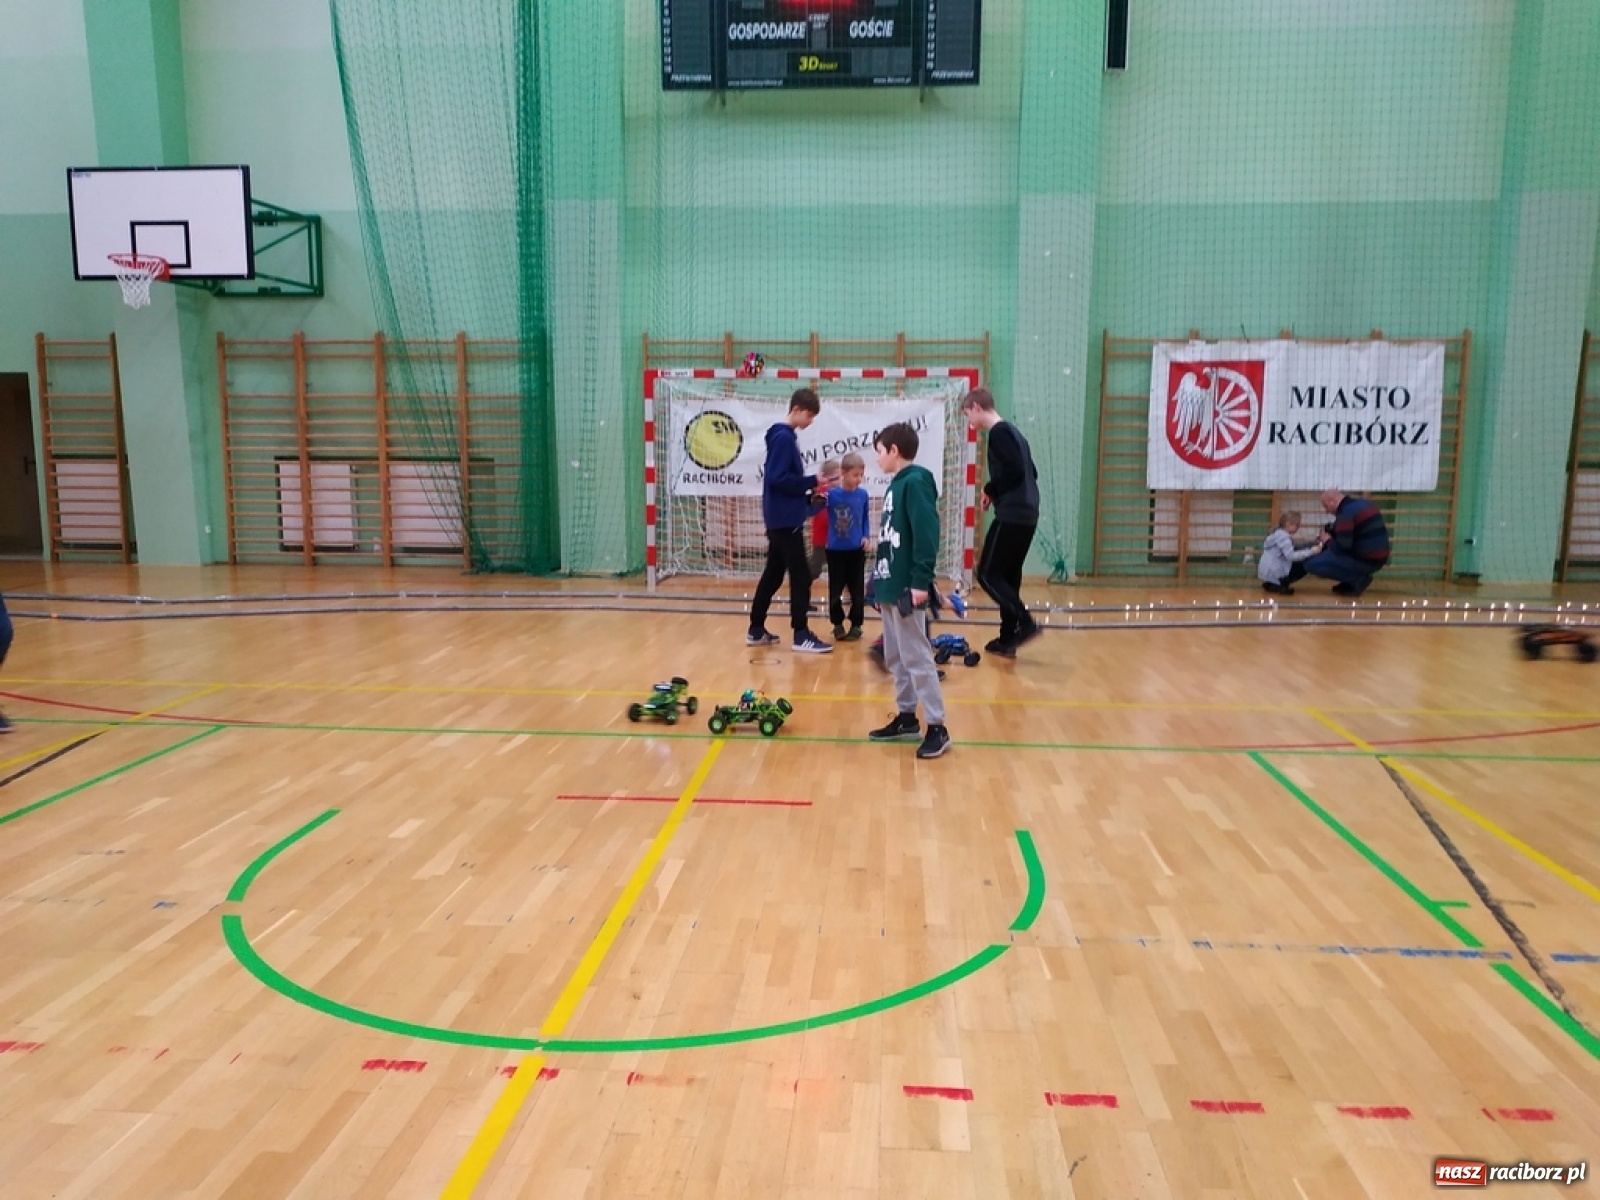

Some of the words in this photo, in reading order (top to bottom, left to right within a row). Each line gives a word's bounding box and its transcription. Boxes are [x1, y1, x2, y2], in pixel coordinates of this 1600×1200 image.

[729, 21, 806, 40] GOSPODARZE
[849, 16, 895, 38] GOŚCIE
[799, 55, 820, 71] 3D
[1289, 385, 1411, 411] MIASTO
[1268, 415, 1429, 445] RACIBÓRZ
[683, 471, 743, 484] RACIBÓRZ
